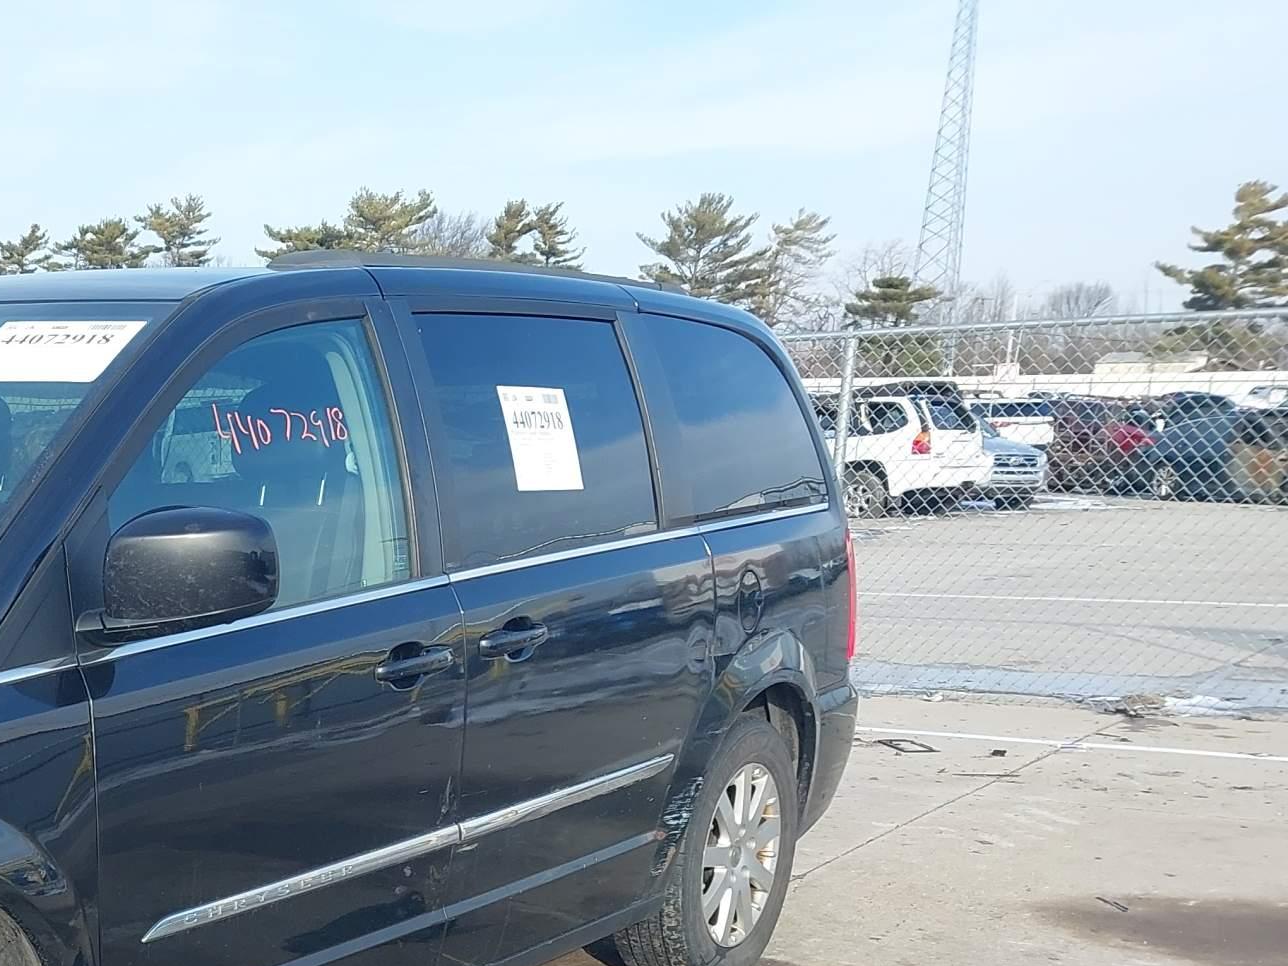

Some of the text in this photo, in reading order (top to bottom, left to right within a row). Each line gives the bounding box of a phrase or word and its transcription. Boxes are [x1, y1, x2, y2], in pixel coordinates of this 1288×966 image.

[1, 333, 116, 345] 44072918
[514, 410, 564, 430] 44072918
[182, 864, 355, 925] CHRYSLER
